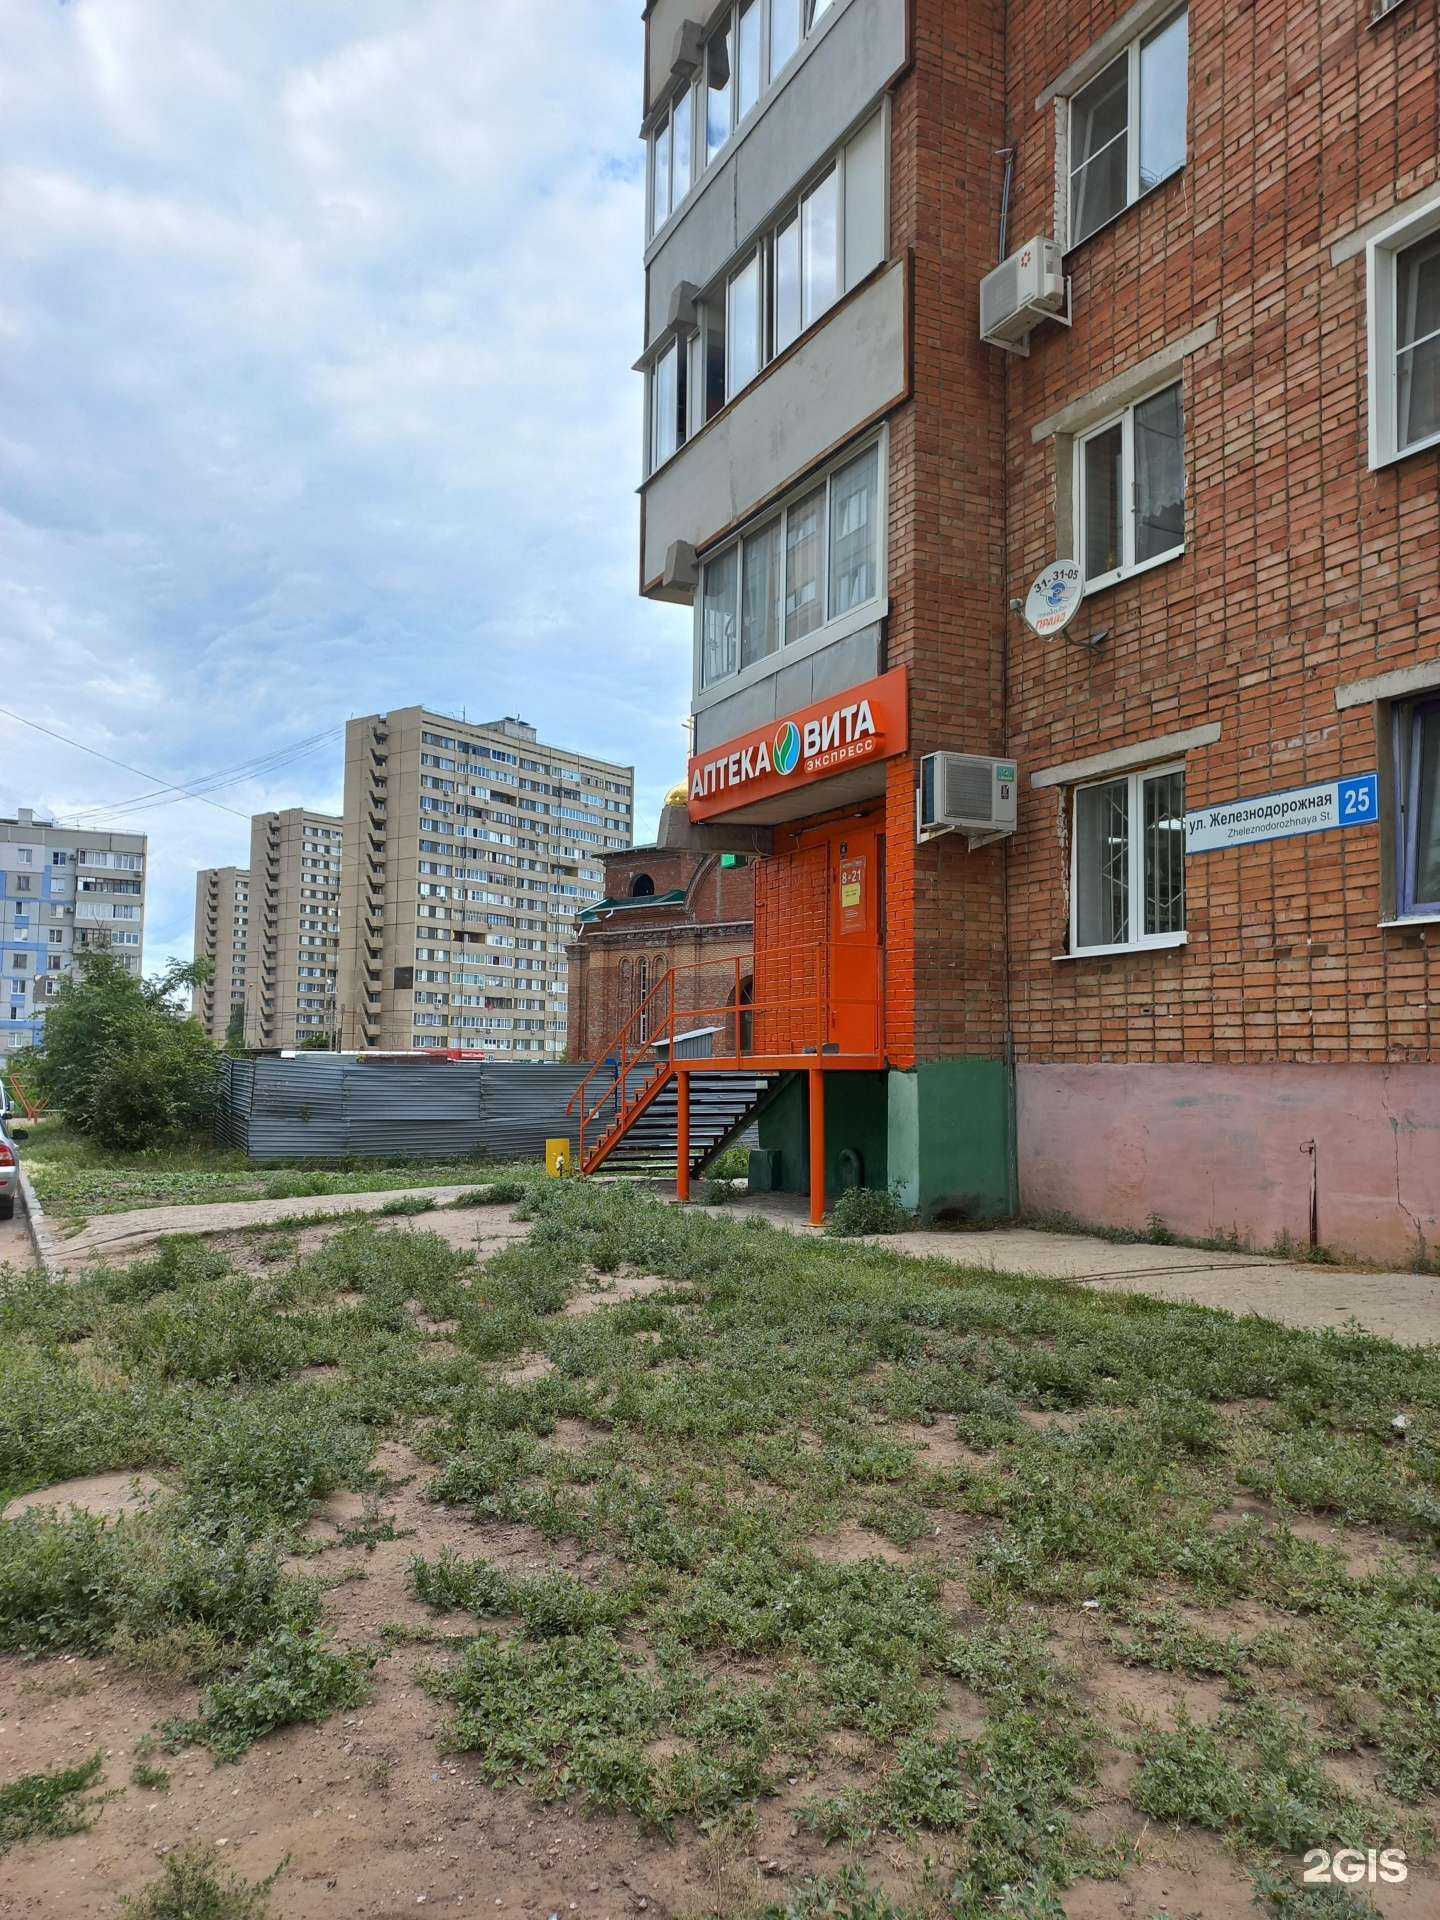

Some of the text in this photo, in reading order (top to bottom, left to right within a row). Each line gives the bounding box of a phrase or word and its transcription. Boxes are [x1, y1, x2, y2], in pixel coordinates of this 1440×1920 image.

[1034, 569, 1079, 593] 31-31-05
[690, 699, 876, 801] АПТЕКА ВИТА
[806, 739, 874, 770] ЭКСПРЕСС
[1189, 793, 1333, 835] ул. Железнодорожная
[1344, 786, 1370, 815] 25
[1227, 811, 1333, 838] Zheleznodorozhnaya St.
